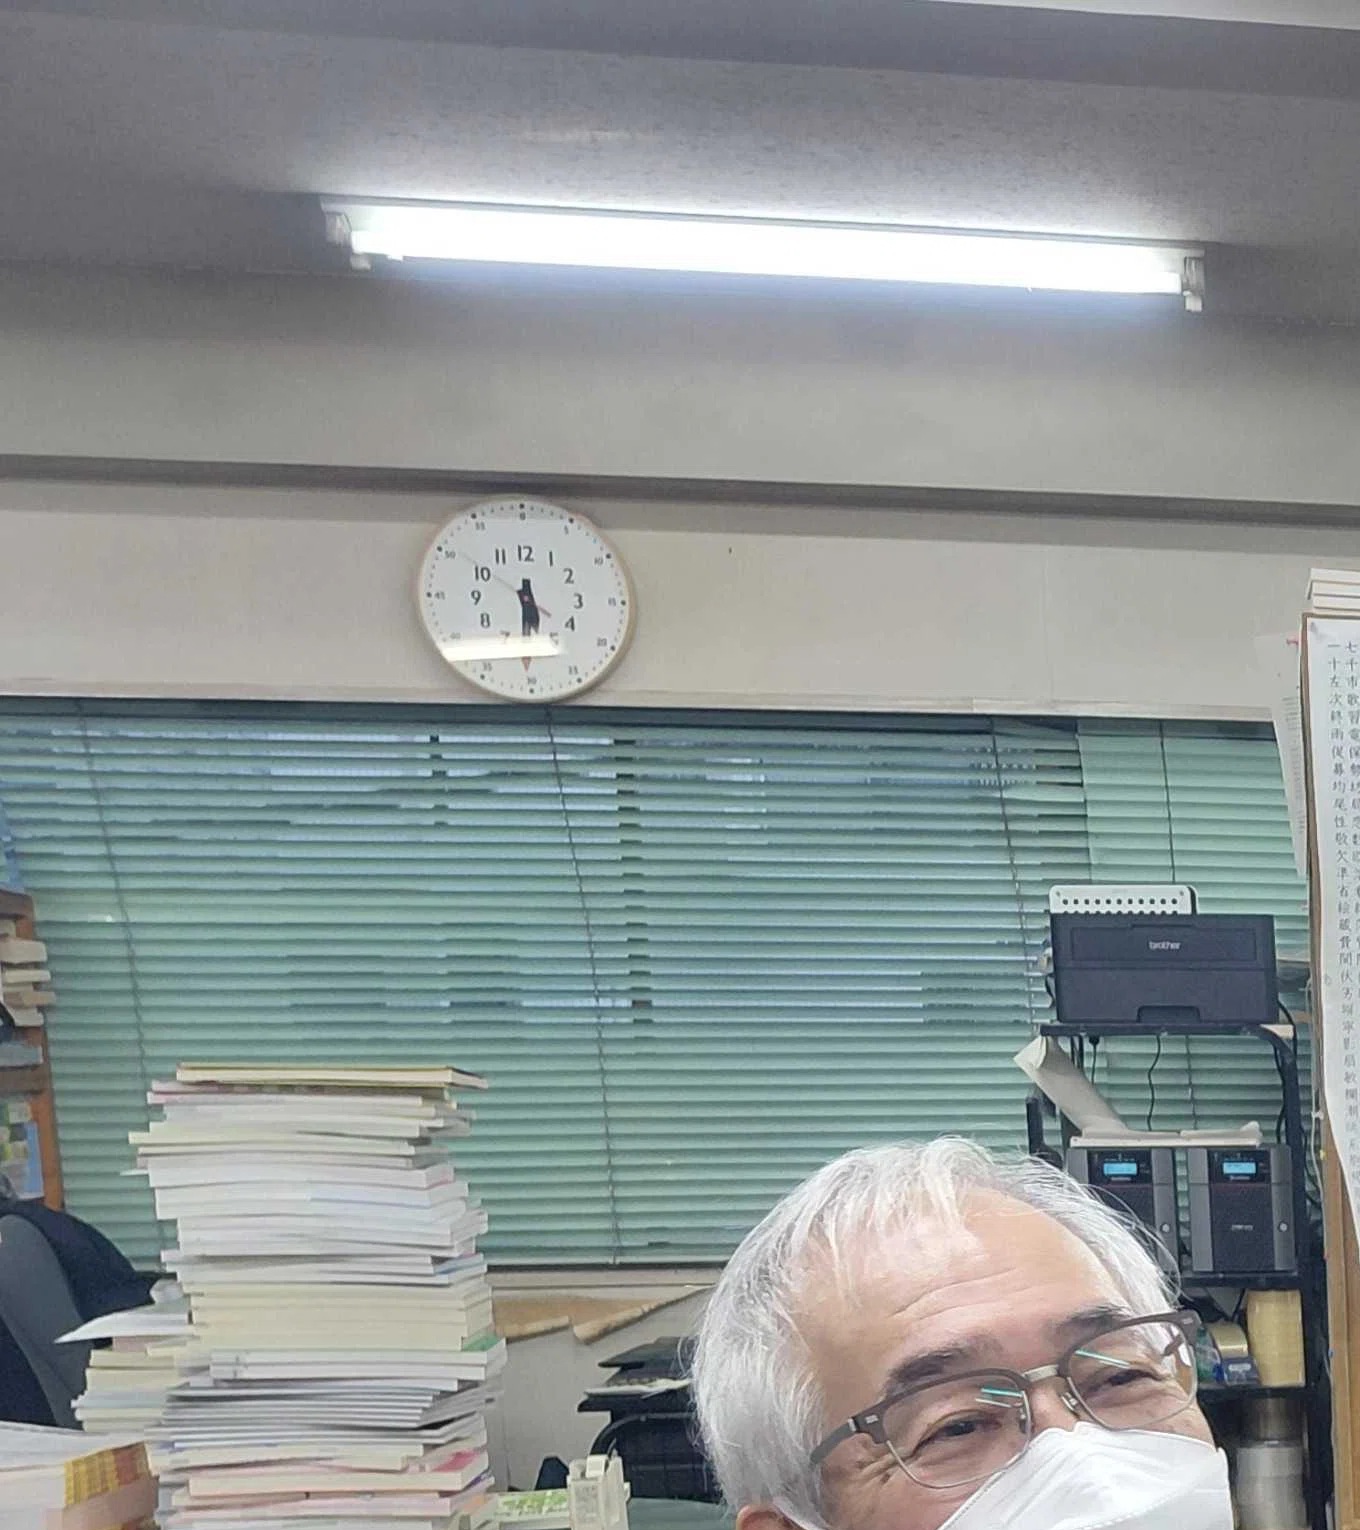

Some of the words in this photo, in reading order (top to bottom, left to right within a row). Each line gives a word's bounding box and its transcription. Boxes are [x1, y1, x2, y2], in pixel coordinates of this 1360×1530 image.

[495, 548, 507, 565] 11
[517, 544, 535, 563] 12
[548, 550, 554, 567] 1
[474, 565, 491, 582] 10
[563, 568, 575, 585] 2
[470, 590, 482, 606] 9
[573, 594, 584, 609] 3
[480, 613, 491, 629] 8
[564, 616, 576, 632] 4
[1148, 940, 1182, 952] brother
